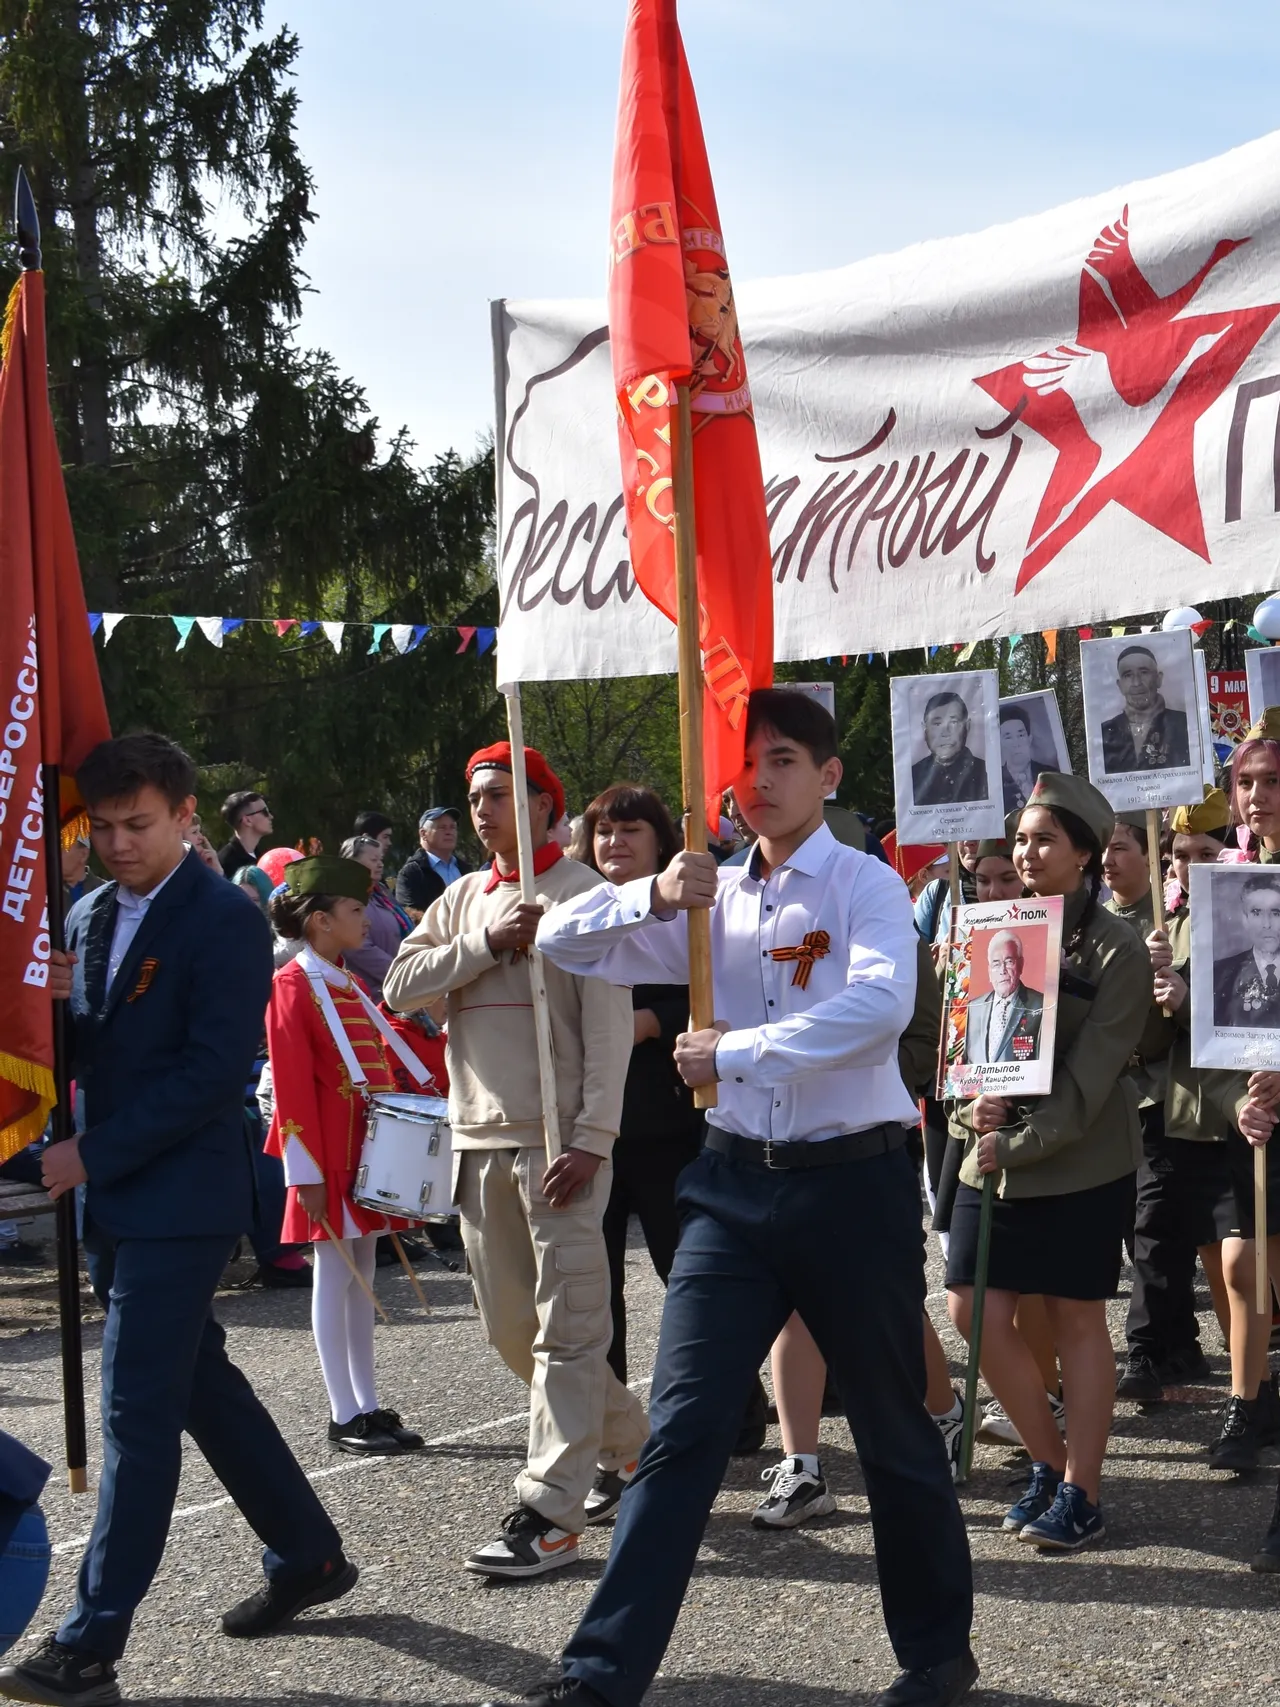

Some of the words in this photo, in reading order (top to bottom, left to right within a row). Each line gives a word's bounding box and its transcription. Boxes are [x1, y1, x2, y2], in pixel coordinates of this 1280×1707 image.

[499, 325, 1028, 628] Бесстный
[1211, 675, 1219, 693] 9
[1224, 680, 1246, 693] МАЯ
[1136, 784, 1160, 792] Рядовой
[1020, 909, 1048, 921] ПОЛК
[1214, 1030, 1245, 1039] Каримов
[974, 1064, 1021, 1075] Латыпов
[959, 1077, 984, 1086] Куддус
